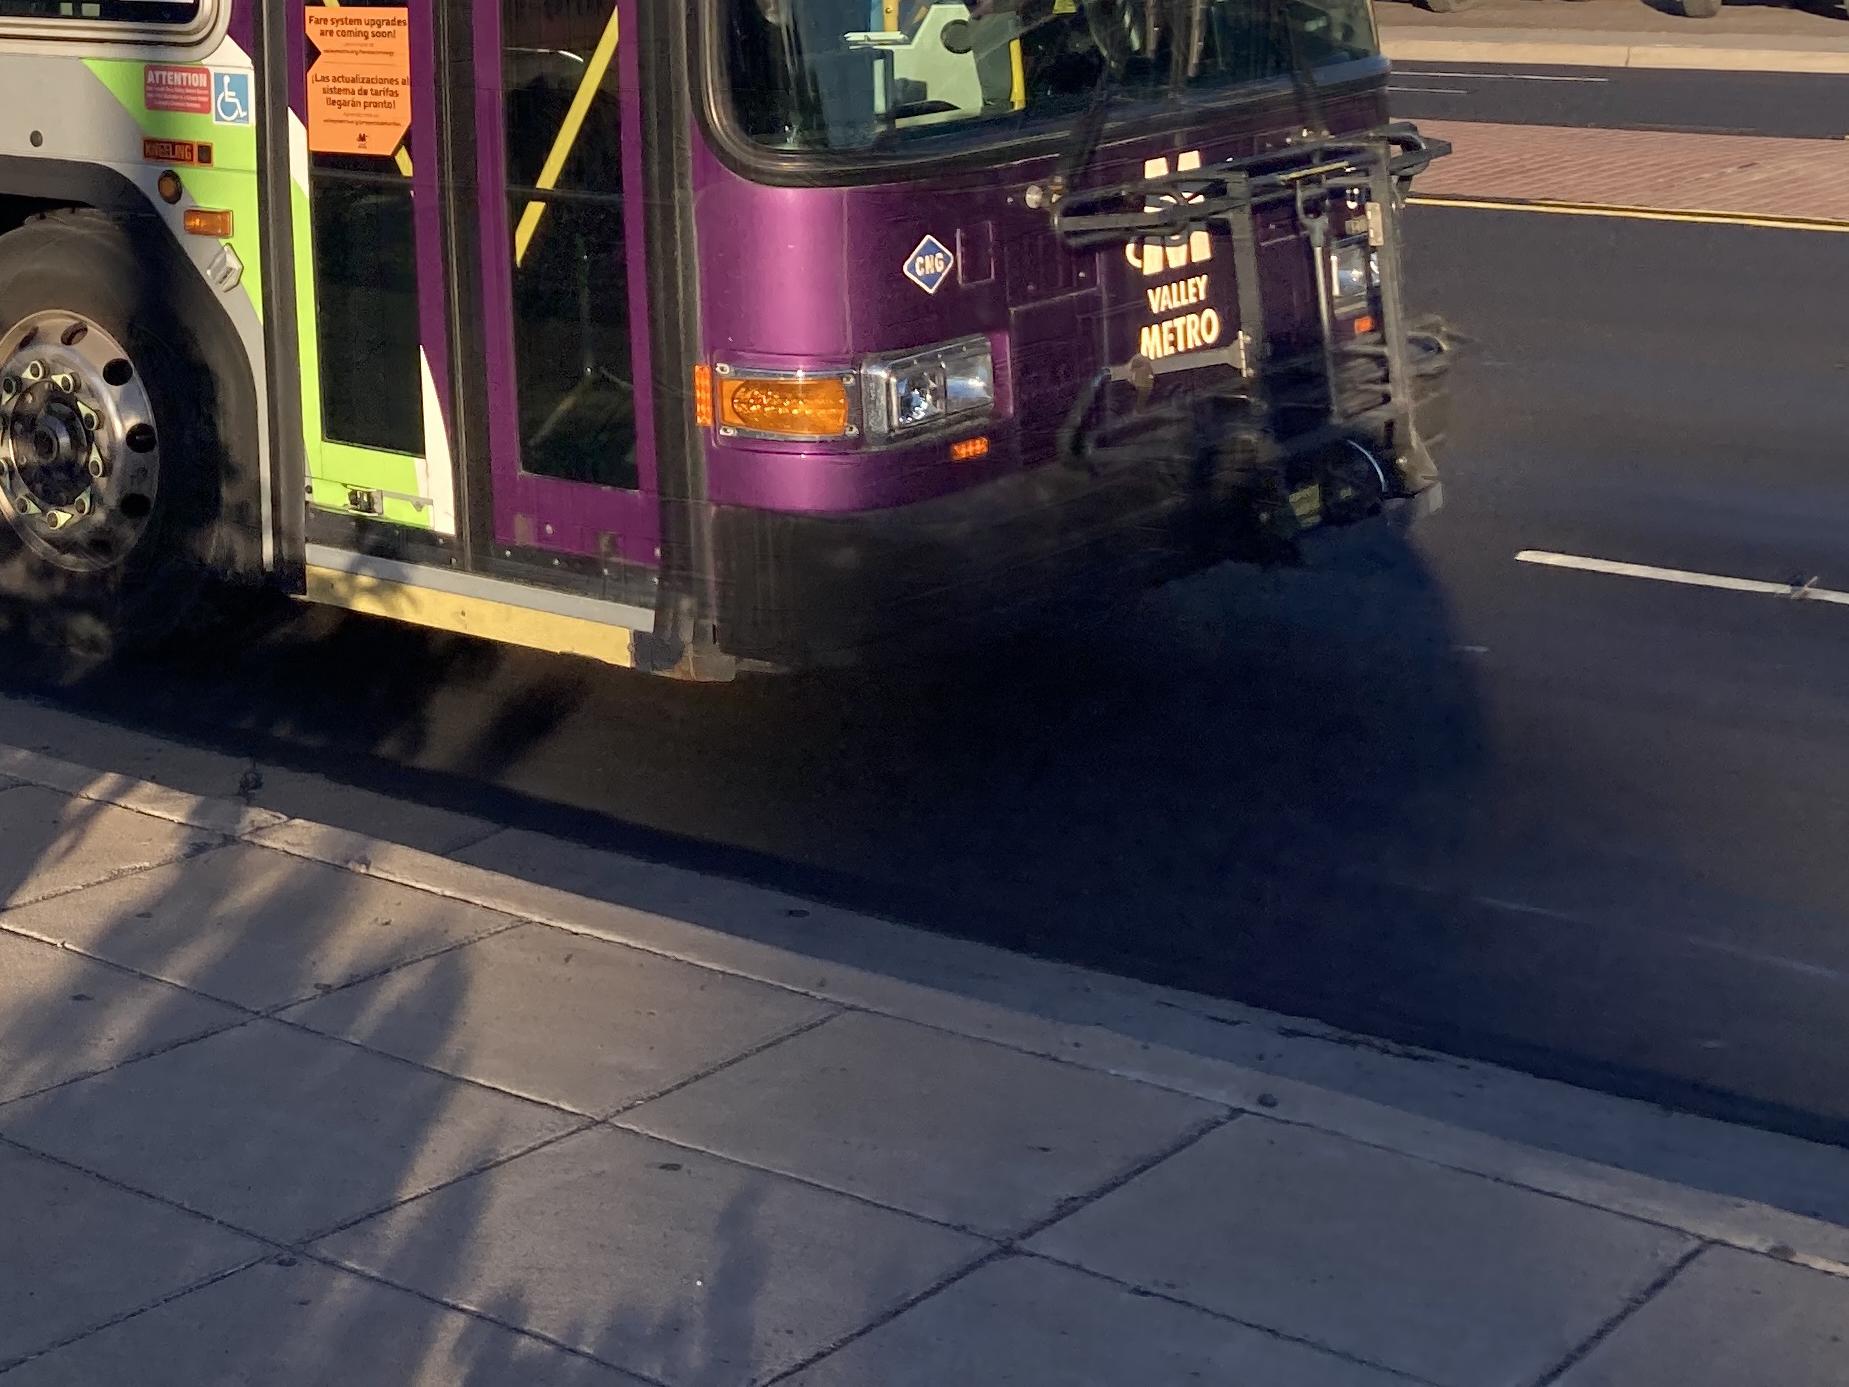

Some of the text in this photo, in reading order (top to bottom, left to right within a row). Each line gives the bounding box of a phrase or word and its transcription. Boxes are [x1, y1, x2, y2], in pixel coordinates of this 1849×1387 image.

[308, 16, 408, 29] Fare system upgrades
[319, 28, 396, 40] are coming soon!
[147, 70, 208, 87] ATTENTION
[331, 74, 400, 86] actualizaciones
[322, 86, 356, 96] sistema
[357, 86, 368, 96] de
[325, 96, 396, 110] llegarán pronto!
[144, 140, 193, 162] KNEELING
[914, 251, 945, 277] CNG
[1147, 274, 1209, 314] VALLEY
[1141, 308, 1221, 361] METRO
